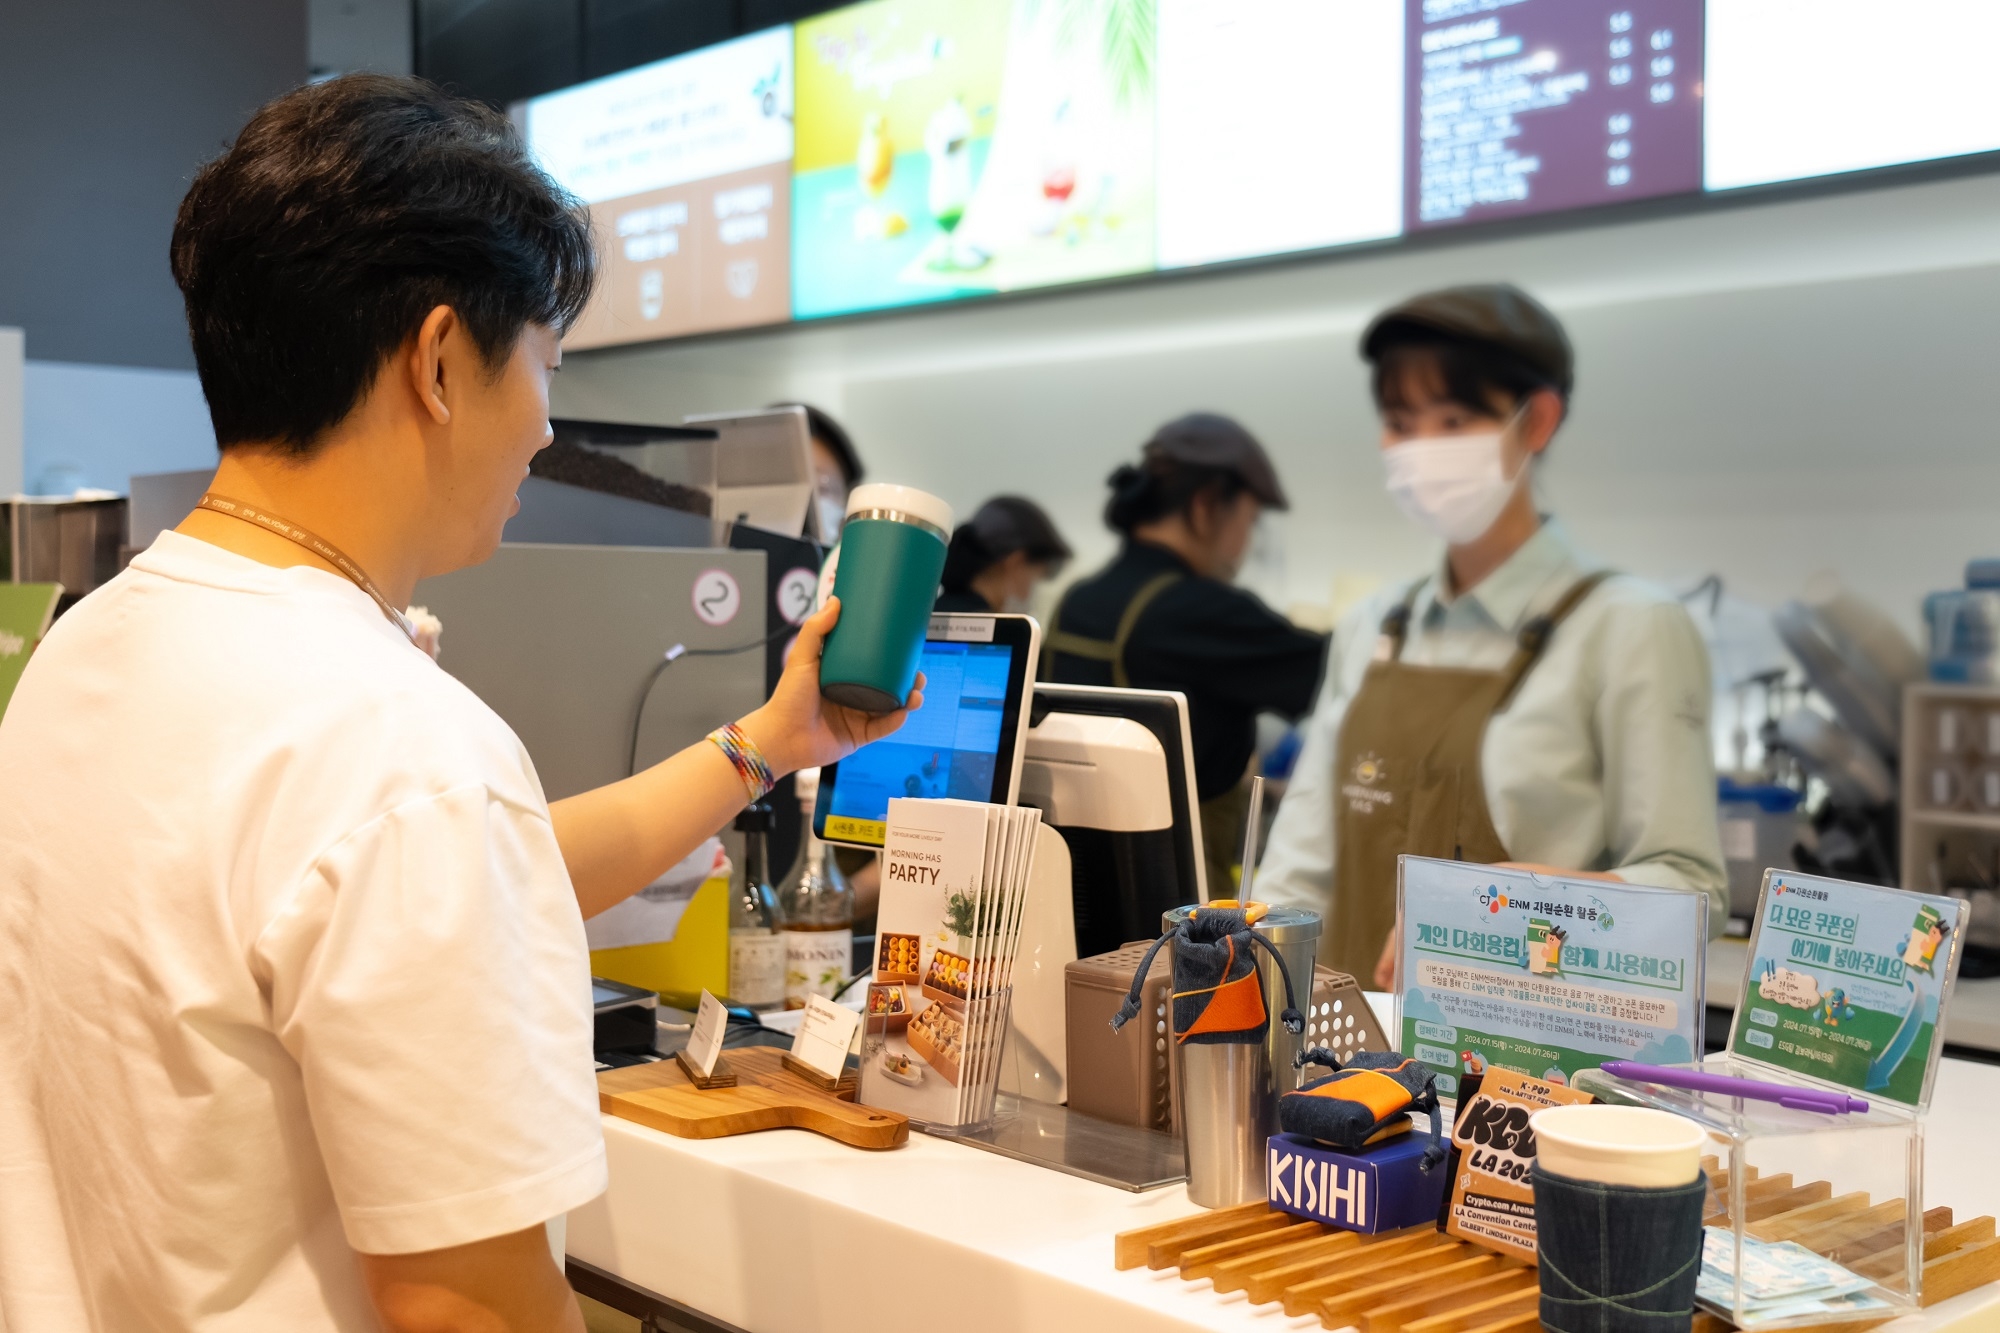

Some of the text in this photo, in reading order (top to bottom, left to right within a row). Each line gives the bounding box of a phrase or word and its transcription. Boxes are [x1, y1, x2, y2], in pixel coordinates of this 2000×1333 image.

[257, 514, 290, 532] ONLYONE
[313, 540, 336, 558] TALENT
[338, 558, 364, 581] ONLYONE
[700, 580, 728, 617] 2
[891, 849, 942, 862] MORNING HAS
[890, 862, 940, 885] PARTY
[1480, 895, 1597, 921] CJ ENM 자원순환 활동
[1770, 904, 1854, 939] 다 모은 쿠폰은
[1416, 923, 1677, 981] 개인 다회용컵 함께 사용해요
[1791, 938, 1903, 979] 여기에 넣어주세요
[1426, 965, 1438, 973] 이번
[1439, 967, 1444, 975] 주
[1517, 980, 1530, 990] 개인
[1570, 989, 1581, 999] 음료
[1584, 992, 1595, 1001] 7번
[1639, 1001, 1665, 1013] 응모하면
[1449, 978, 1461, 988] 통해
[1463, 982, 1470, 990] CJ
[1472, 983, 1485, 992] ENM
[1543, 996, 1563, 1006] 제작한
[1620, 1008, 1653, 1021] 증정합니다
[1487, 1003, 1504, 1012] 마음과
[1507, 1006, 1518, 1016] 작은
[1419, 1025, 1438, 1036] 캠페인
[1440, 1030, 1453, 1040] 기간
[1421, 1047, 1449, 1063] 참여 방법
[1499, 1086, 1510, 1094] FAN
[1515, 1092, 1536, 1100] ARTIST
[1520, 1081, 1550, 1095] K-POP
[1470, 1150, 1498, 1173] LA
[1270, 1148, 1366, 1226] KISIHI
[1466, 1194, 1535, 1215] Crypto.com Arena
[1455, 1208, 1537, 1231] LA Convention Cente
[1460, 1220, 1533, 1248] GILBERT LINDSAY PLAZA
